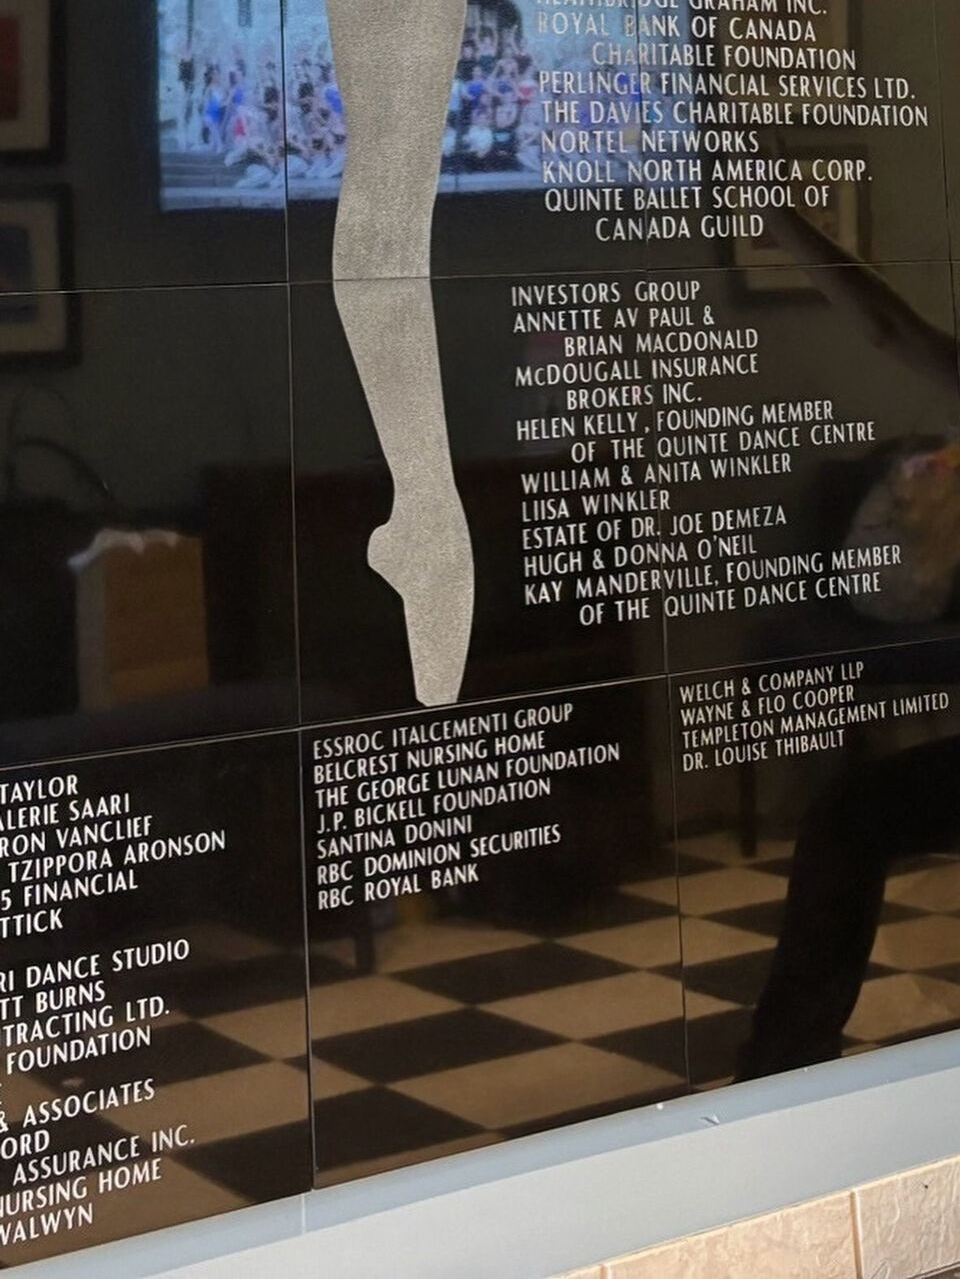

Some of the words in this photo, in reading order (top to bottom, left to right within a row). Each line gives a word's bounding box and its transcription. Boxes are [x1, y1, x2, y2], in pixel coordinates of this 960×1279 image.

[542, 101, 580, 124] THE
[590, 101, 663, 125] DAVIES
[673, 102, 794, 126] CHARITABLE
[802, 103, 928, 127] FOUNDATION
[543, 160, 615, 183] KNOLL
[628, 160, 700, 182] NORTH
[712, 159, 802, 182] AMERICA
[813, 159, 873, 181] CORP.
[545, 188, 622, 212] QUINTE
[634, 187, 701, 210] BALLET
[712, 185, 795, 209] SCHOOL
[805, 185, 830, 208] OF
[595, 216, 690, 241] CANADA
[701, 215, 764, 239] GUILD
[512, 283, 620, 307] INVESTORS
[635, 281, 700, 302] GROUP
[565, 335, 623, 357] BRIAN
[636, 329, 758, 354] MACDONALD
[652, 354, 758, 379] INSURANCE
[567, 385, 653, 410] BROKERS
[663, 382, 702, 405] INC.
[522, 497, 569, 521] LIISA
[582, 490, 670, 517] WINKLER
[524, 551, 582, 577] HUGH
[593, 549, 604, 570] &
[614, 541, 688, 568] DONNA
[698, 535, 756, 560] O'NEIL
[525, 580, 563, 605] KAY
[727, 553, 823, 584] FOUNDING
[831, 545, 901, 572] MEMBER
[680, 702, 733, 726] WAYNE
[742, 700, 750, 717] &
[759, 695, 785, 715] FLO
[793, 685, 854, 710] COOPER
[682, 718, 774, 749] TEMPLETON
[781, 702, 886, 734] MANAGEMENT
[893, 692, 949, 717] LIMITED
[314, 753, 398, 784] BELCREST
[407, 740, 487, 770] NURSING
[495, 731, 545, 756] HOME
[683, 750, 708, 772] DR.
[715, 741, 768, 767] LOUISE
[775, 729, 844, 757] THIBAULT
[0, 774, 78, 804] TAYLOR
[315, 784, 349, 809] THE
[357, 772, 430, 802] GEORGE
[438, 761, 498, 789] LUNAN
[506, 743, 620, 778] FOUNDATION
[8, 847, 112, 883] TZIPPORA
[124, 830, 225, 865] ARONSON
[317, 827, 395, 858] SANTINA
[405, 815, 472, 844] DONINI
[318, 860, 353, 885] RBC
[365, 841, 460, 877] DOMINION
[470, 824, 561, 858] SECURITIES
[7, 1025, 151, 1075] FOUNDATION
[23, 1078, 155, 1128] ASSOCIATES
[13, 1136, 139, 1185] ASSURANCE
[152, 1124, 195, 1154] INC.
